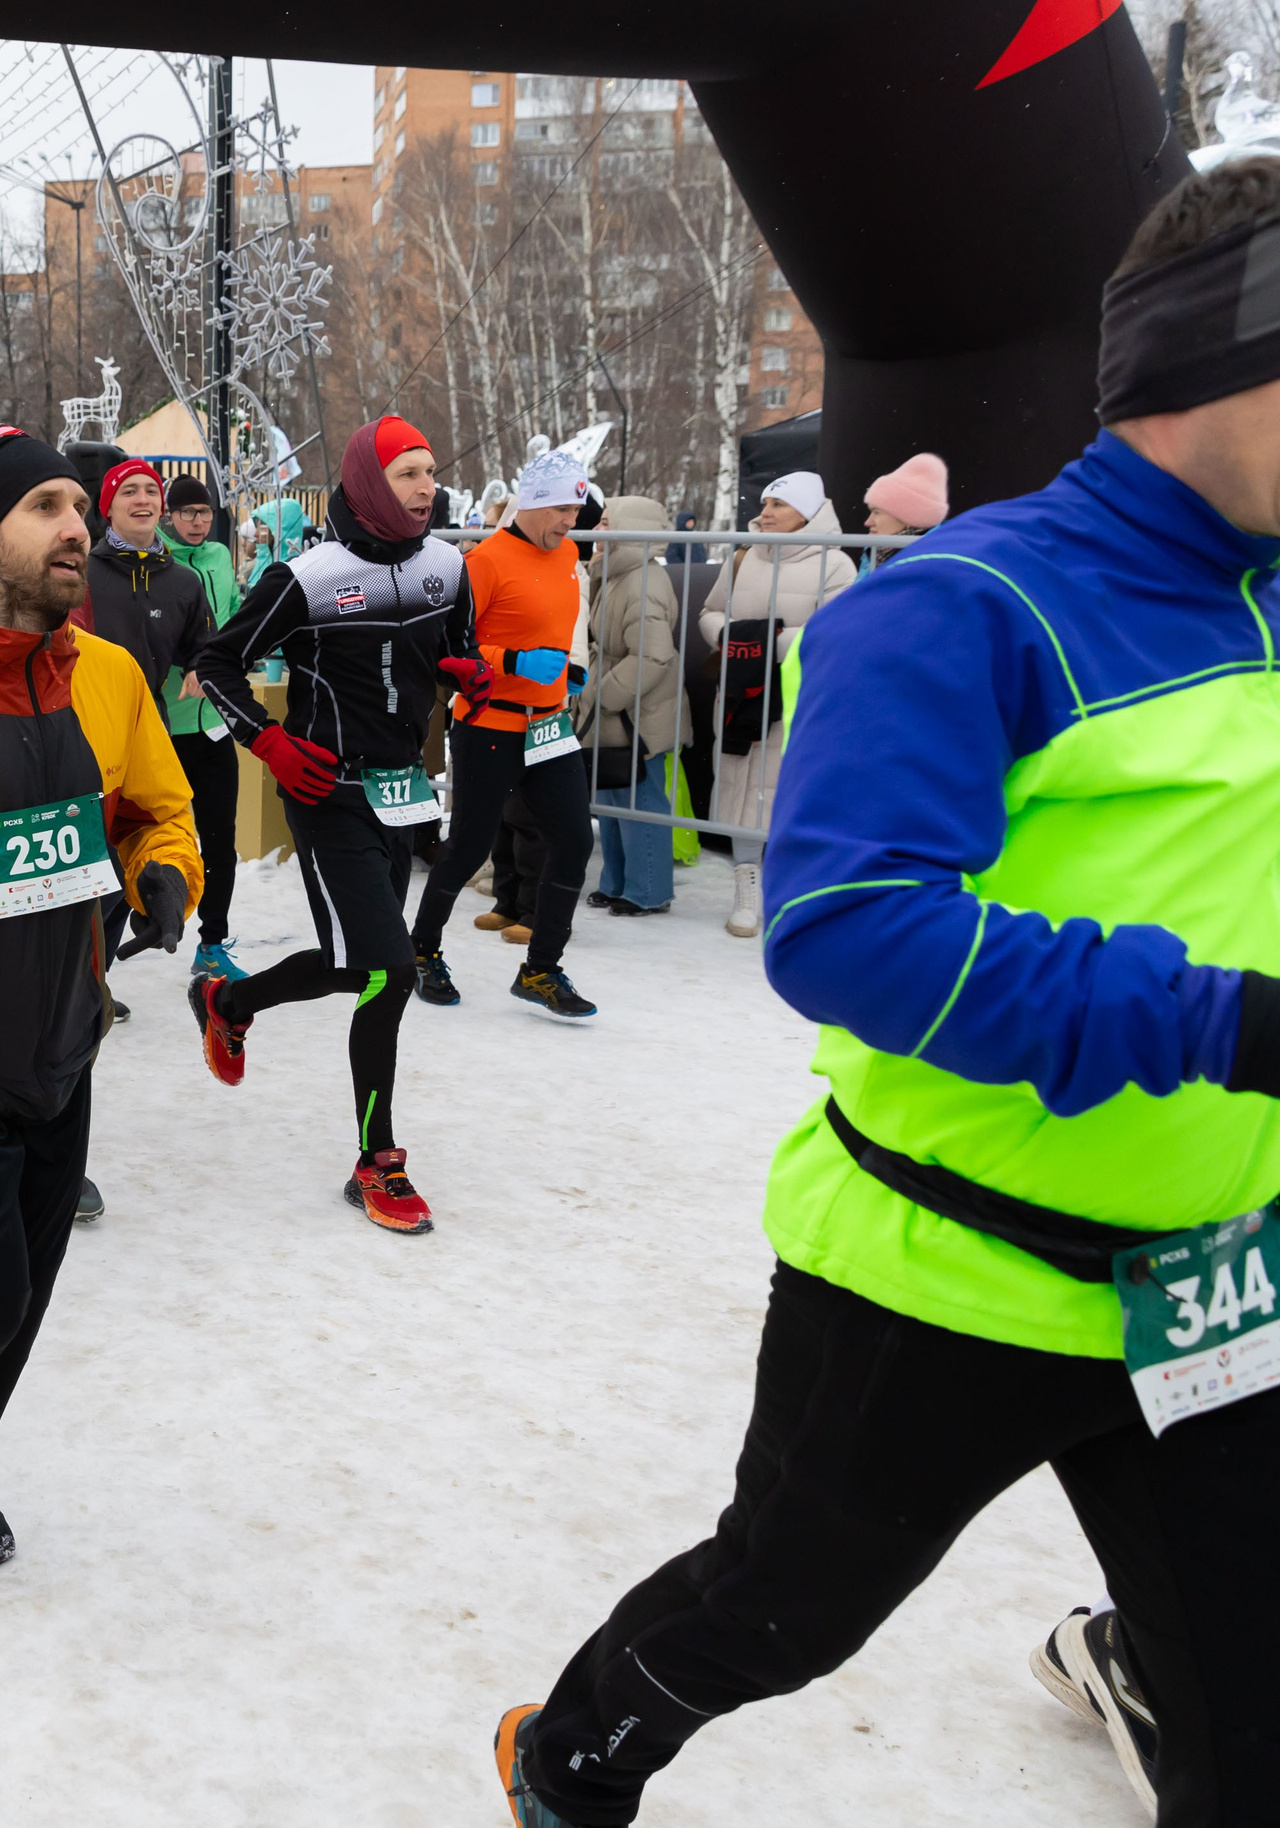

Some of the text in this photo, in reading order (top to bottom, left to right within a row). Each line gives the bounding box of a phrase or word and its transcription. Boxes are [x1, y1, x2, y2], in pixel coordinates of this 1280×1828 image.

[381, 640, 398, 714] MOUNTAIN URAL
[534, 721, 561, 746] 018
[378, 777, 411, 805] 317
[3, 818, 24, 828] РСХБ
[6, 824, 81, 876] 230
[1165, 1246, 1277, 1348] 344
